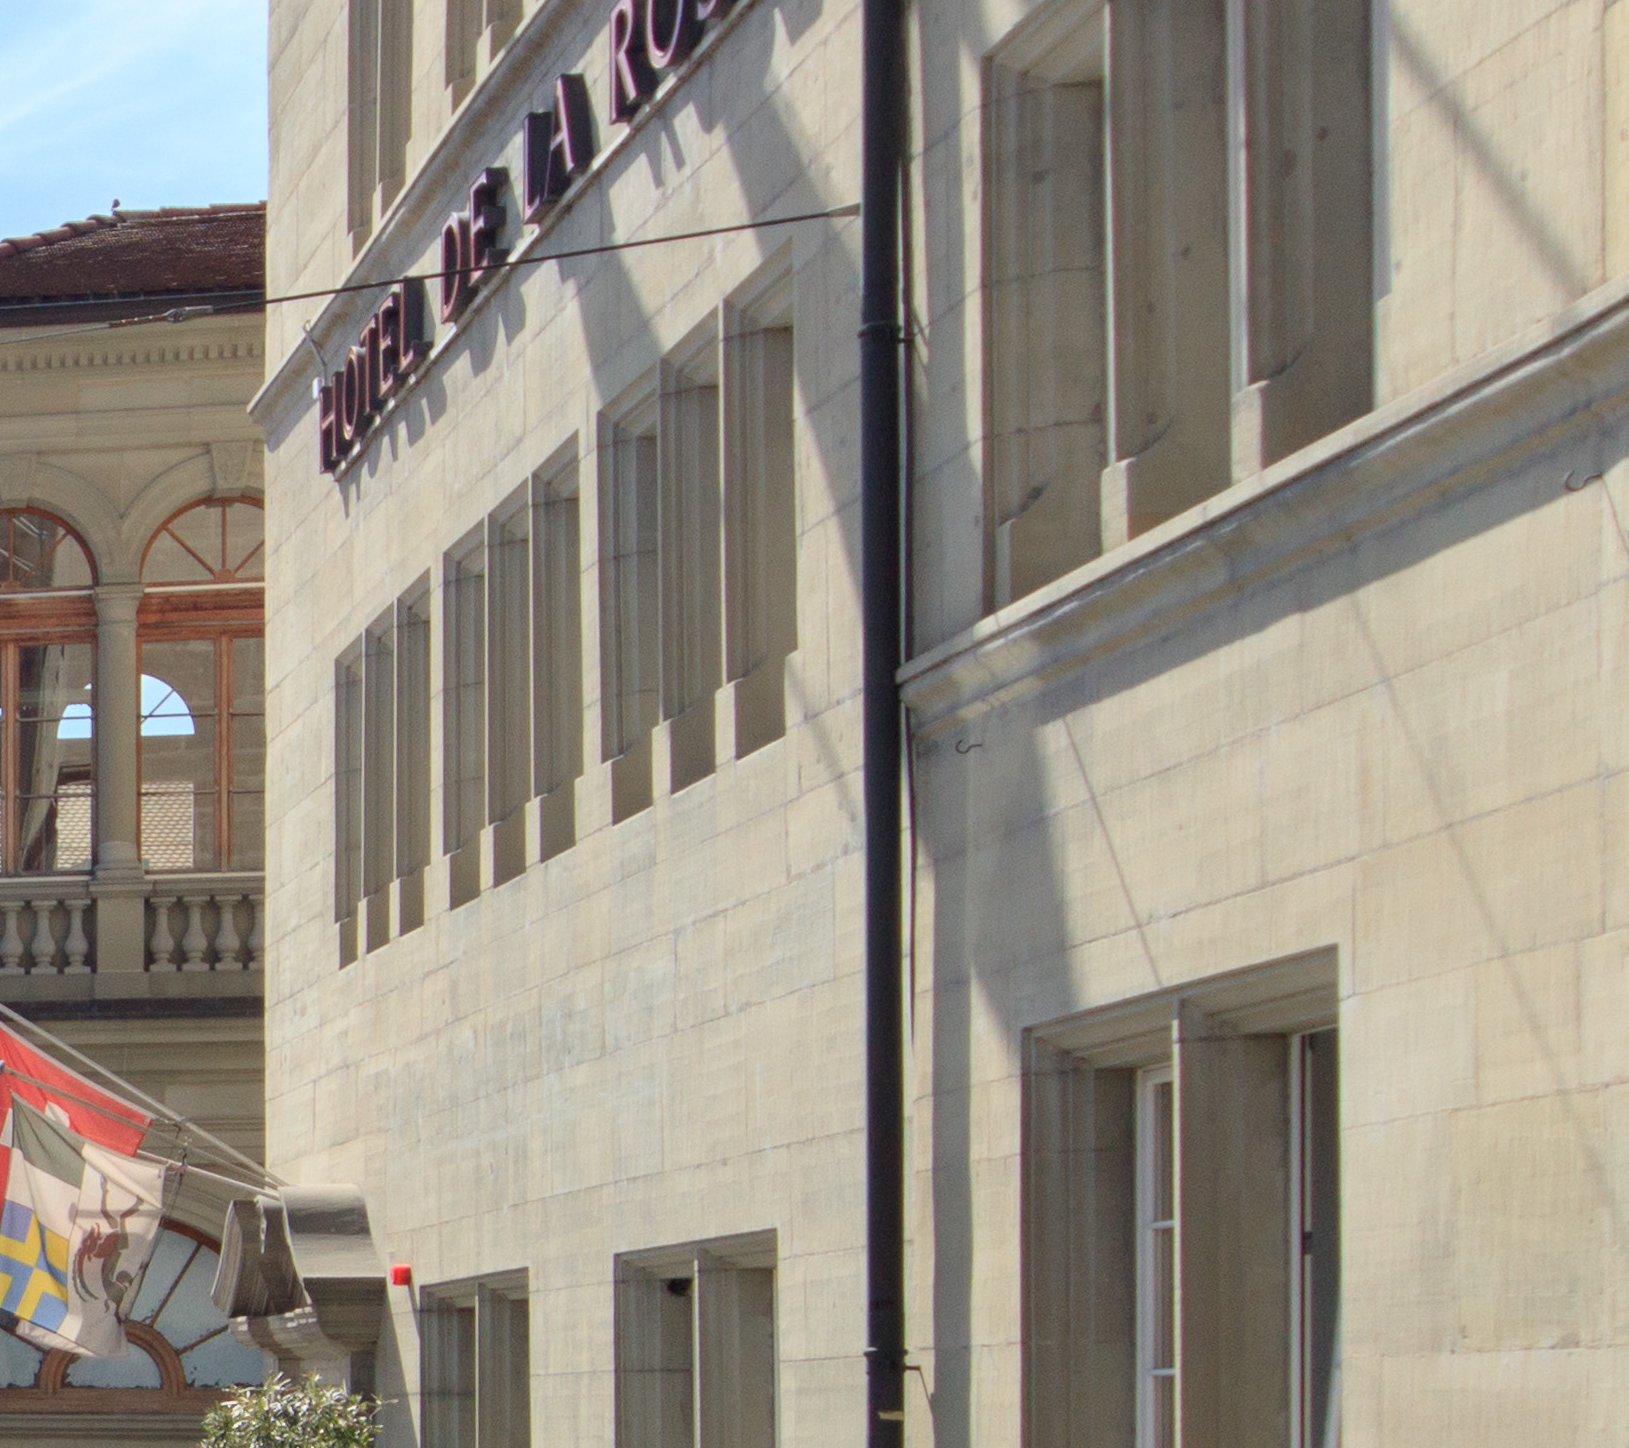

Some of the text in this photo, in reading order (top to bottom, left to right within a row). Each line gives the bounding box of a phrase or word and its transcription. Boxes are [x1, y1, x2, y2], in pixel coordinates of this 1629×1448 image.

[319, 276, 433, 474] HOTEL
[441, 167, 509, 323] DE
[523, 73, 596, 224] LA
